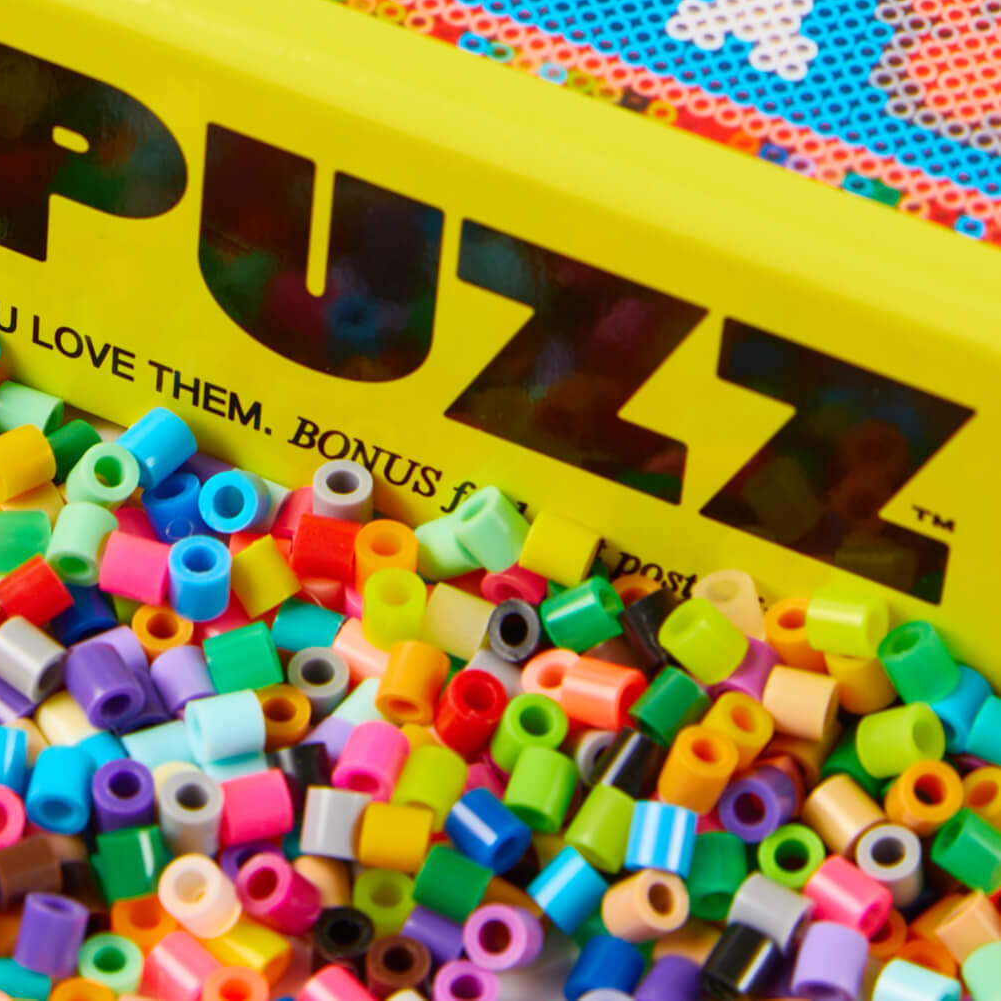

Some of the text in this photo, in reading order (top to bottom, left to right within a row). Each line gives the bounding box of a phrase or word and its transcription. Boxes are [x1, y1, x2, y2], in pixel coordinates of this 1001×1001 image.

[31, 315, 136, 382] LOVE
[148, 359, 272, 435] THEM.
[287, 416, 443, 498] BONUS
